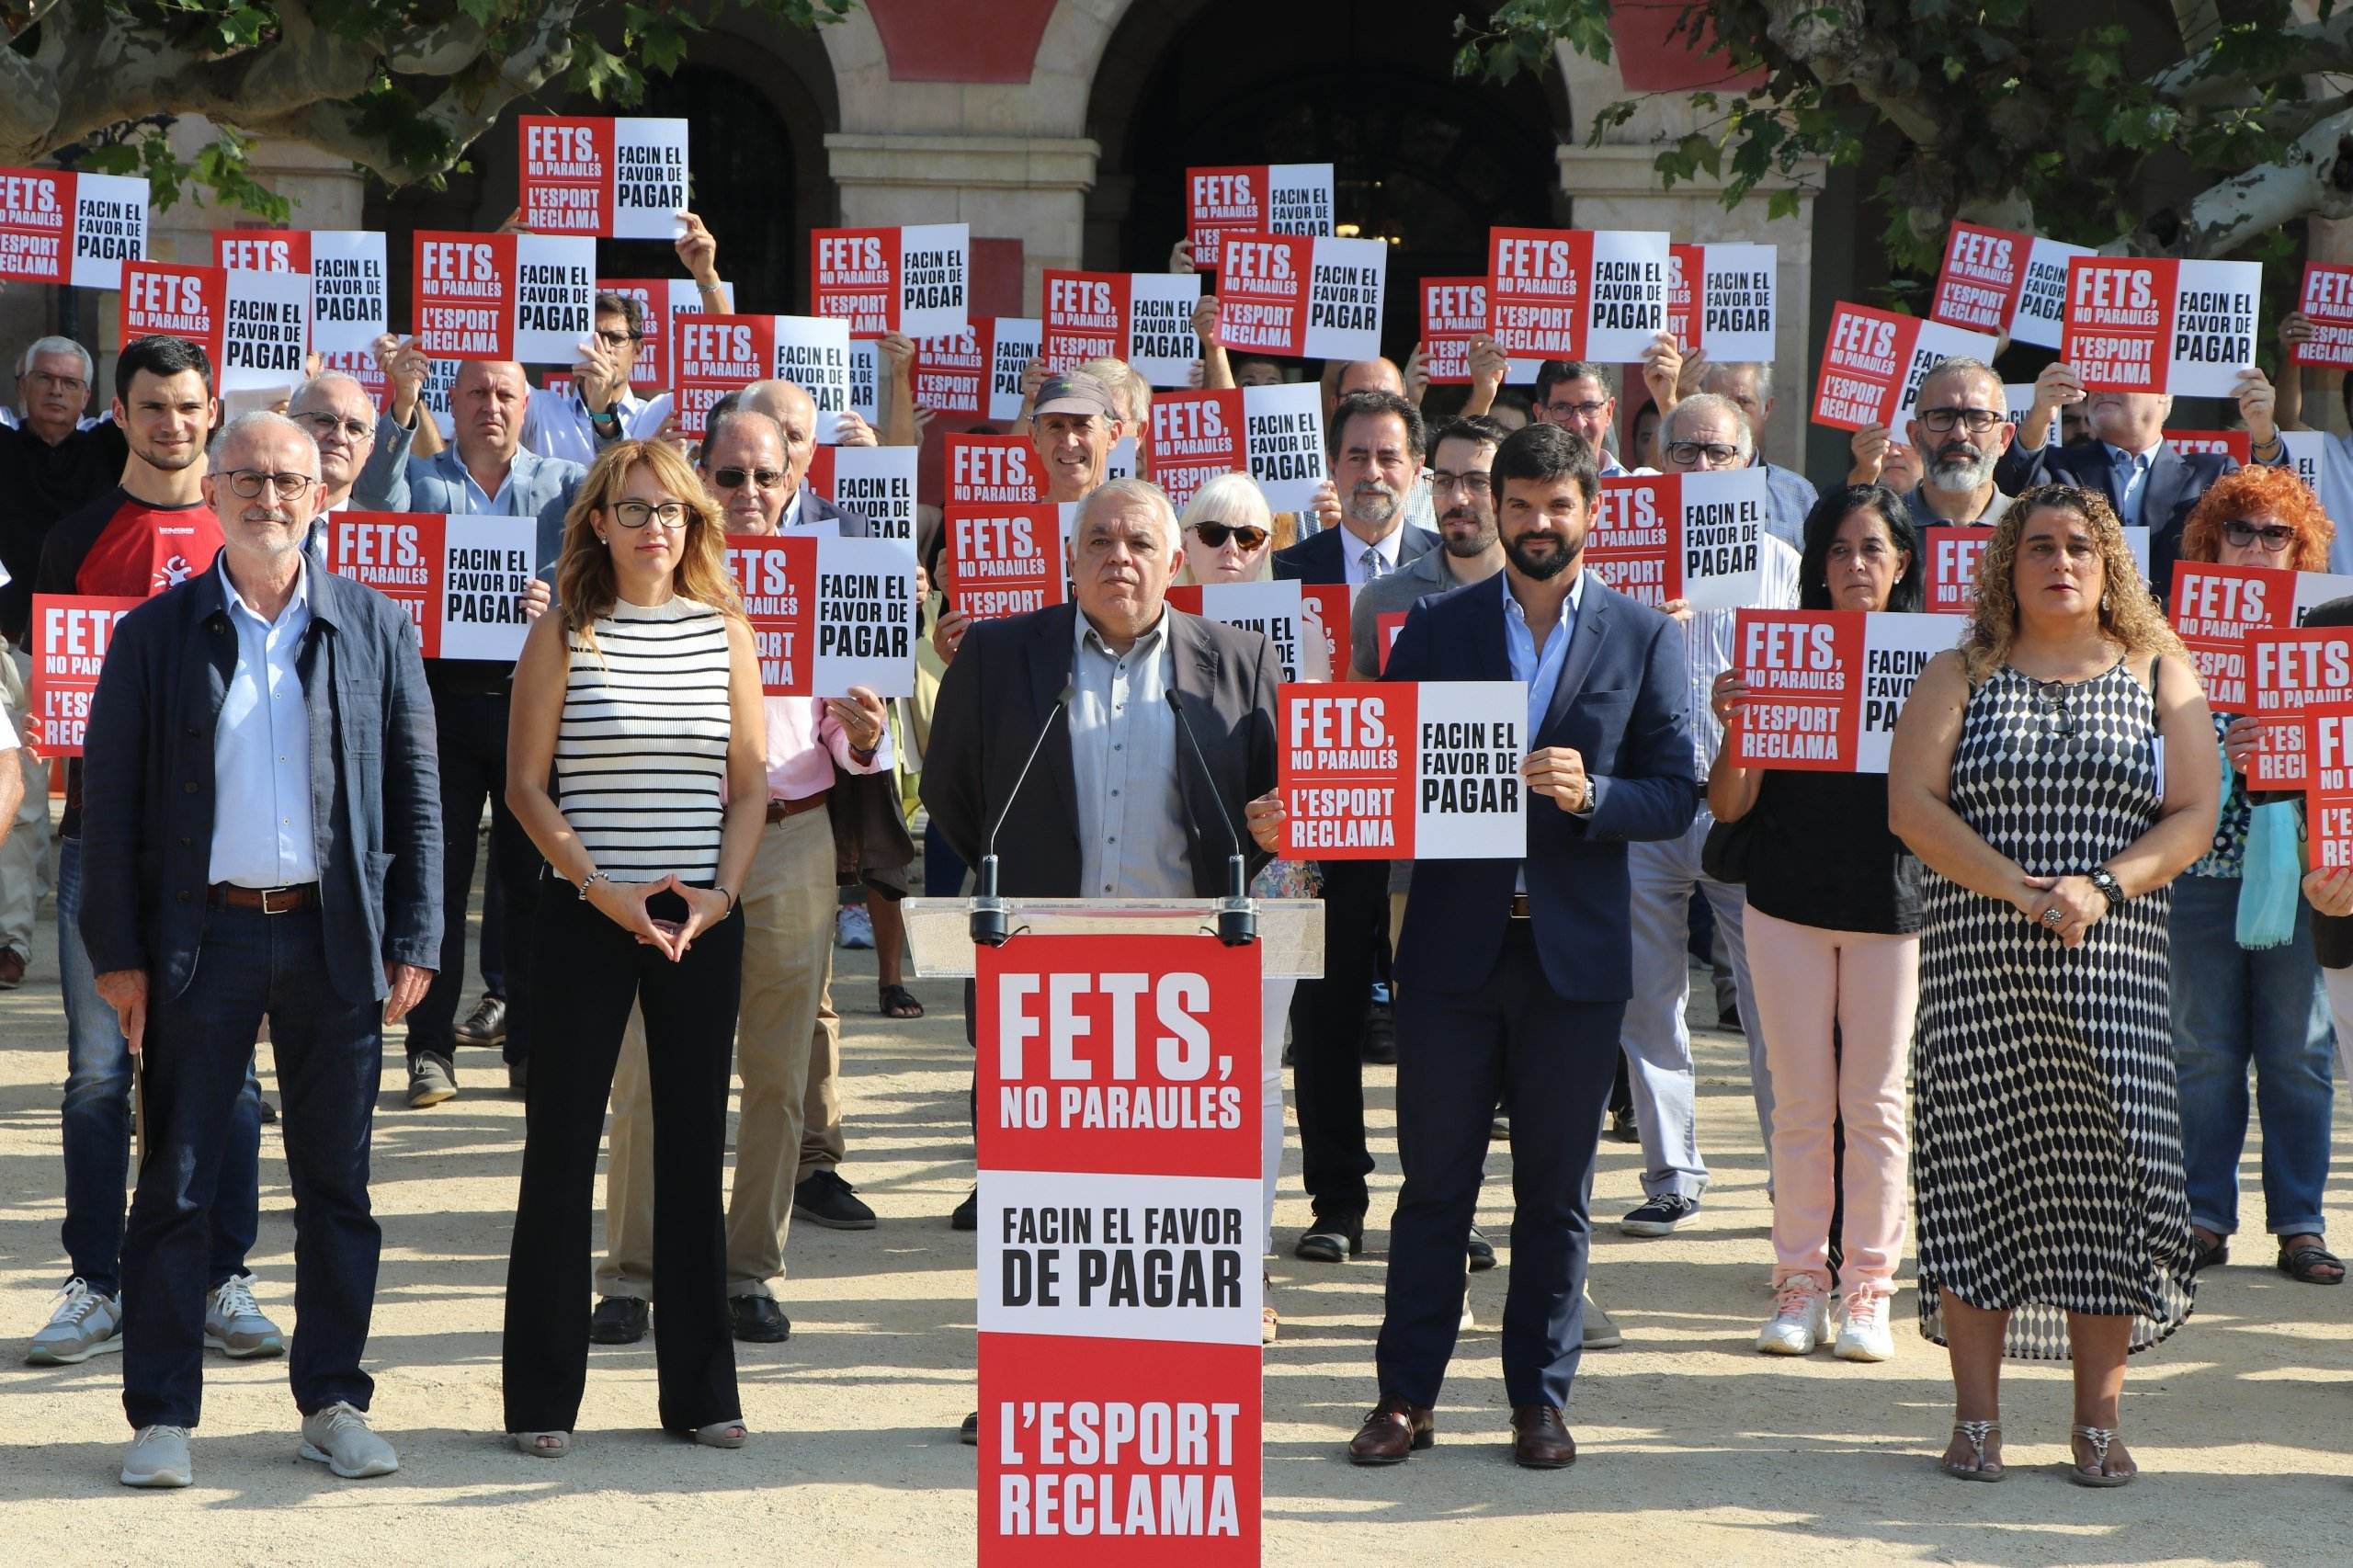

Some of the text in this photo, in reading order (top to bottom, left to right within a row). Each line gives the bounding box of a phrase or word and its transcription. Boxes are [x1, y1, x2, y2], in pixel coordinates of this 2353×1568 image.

[529, 126, 599, 162] FETS,
[619, 146, 682, 165] FACIN EL
[529, 161, 601, 176] NO PARAULES
[619, 166, 682, 182] FAVOR DE
[529, 187, 599, 208] L'ESPORT
[619, 184, 683, 208] PAGAR
[1195, 176, 1256, 206] FETS,
[1272, 188, 1328, 205] FACIN EL
[79, 199, 142, 222] FACIN EL
[529, 209, 599, 229] RECLAMA
[79, 219, 141, 237] FAVOR DE
[78, 234, 141, 261] PAGAR
[820, 238, 887, 270] FETS,
[905, 250, 962, 269] FACIN EL
[1498, 239, 1574, 278] FETS,
[1952, 231, 2014, 271] FETS,
[315, 259, 381, 278] FACIN EL
[423, 242, 499, 281] FETS,
[1225, 241, 1296, 279] FETS,
[1596, 262, 1663, 282] FACIN EL
[316, 279, 381, 294] FAVOR DE
[520, 265, 589, 286] FACIN EL
[904, 268, 962, 286] FAVOR DE
[1225, 277, 1298, 295] NO PARAULES
[1314, 265, 1378, 287] FACIN EL
[1497, 278, 1576, 295] NO PARAULES
[1707, 273, 1769, 290] FACIN EL
[129, 272, 208, 315] FETS,
[423, 279, 502, 297] NO PARAULES
[520, 287, 588, 304] FAVOR DE
[904, 285, 962, 310] PAGAR
[1051, 279, 1116, 314] FETS,
[1313, 285, 1378, 304] FAVOR DE
[1596, 284, 1662, 301] FAVOR DE
[1707, 292, 1769, 307] FAVOR DE
[1943, 282, 2006, 310] L'ESPORT
[2075, 267, 2157, 309] FETS,
[229, 300, 301, 324] FACIN EL
[316, 296, 382, 320] PAGAR
[820, 295, 887, 313] L'ESPORT
[1222, 303, 1293, 326] L'ESPORT
[2180, 292, 2254, 314] FACIN EL
[128, 311, 210, 332] NO PARAULES
[423, 308, 499, 330] L'ESPORT
[519, 305, 589, 332] PAGAR
[1312, 302, 1377, 331] PAGAR
[1495, 306, 1573, 329] L'ESPORT
[1594, 302, 1662, 330] PAGAR
[1707, 309, 1769, 332] PAGAR
[2075, 307, 2159, 325] NO PARAULES
[2178, 314, 2252, 334] FAVOR DE
[229, 322, 301, 343] FAVOR DE
[422, 330, 498, 352] RECLAMA
[683, 324, 757, 362] FETS,
[1221, 324, 1291, 347] RECLAMA
[1833, 312, 1897, 358] FETS,
[227, 341, 301, 371] PAGAR
[779, 346, 844, 367] FACIN EL
[1050, 336, 1115, 357] L'ESPORT
[1133, 335, 1194, 358] PAGAR
[2071, 336, 2154, 360] L'ESPORT
[2176, 335, 2251, 363] PAGAR
[683, 361, 760, 378] NO PARAULES
[918, 374, 979, 393] L'ESPORT
[1824, 374, 1886, 407] L'ESPORT
[1153, 400, 1229, 440] FETS,
[1819, 396, 1879, 424] RECLAMA
[1249, 413, 1317, 436] FACIN EL
[1250, 434, 1318, 454] FAVOR DE
[954, 447, 1033, 485] FETS,
[1252, 453, 1321, 482] PAGAR
[954, 485, 1036, 502] NO PARAULES
[1686, 501, 1758, 528] FACIN EL
[338, 523, 426, 566] FETS,
[955, 517, 1041, 560] FETS,
[1687, 524, 1758, 548] FAVOR DE
[449, 548, 529, 572] FACIN EL
[958, 559, 1045, 577] NO PARAULES
[1688, 544, 1758, 578] PAGAR
[821, 574, 908, 599] FACIN EL
[2180, 574, 2271, 623] FETS,
[821, 601, 907, 623] FAVOR DE
[821, 625, 908, 658] PAGAR
[1746, 622, 1842, 670] FETS,
[1769, 670, 1845, 690] PARAULES
[1291, 698, 1394, 748] FETS,
[1423, 723, 1518, 749] FACIN EL
[1742, 733, 1838, 760] RECLAMA
[1291, 750, 1397, 770] NO PARAULES
[1423, 753, 1517, 775] FAVOR DE
[1292, 789, 1394, 817] L'ESPORT
[1423, 778, 1518, 813] PAGAR
[1292, 820, 1394, 847] RECLAMA
[999, 972, 1232, 1080] FETS,
[1001, 1086, 1240, 1129] NO PARAULES
[1004, 1208, 1241, 1244] FACIN EL FAVOR
[1003, 1249, 1241, 1307] DE PAGAR
[1001, 1403, 1239, 1465] L'ESPORT
[1001, 1474, 1239, 1536] RECLAMA
